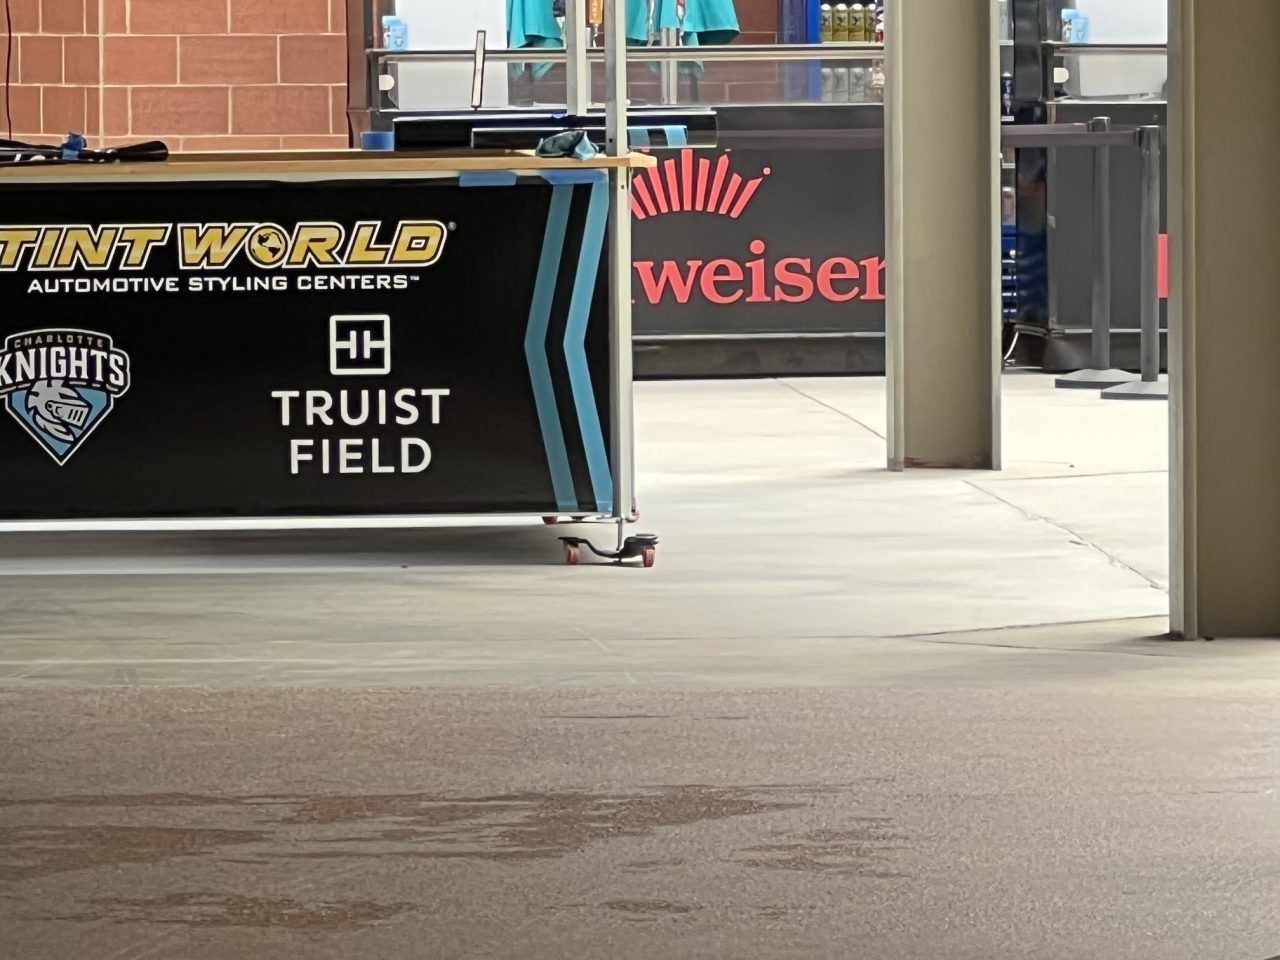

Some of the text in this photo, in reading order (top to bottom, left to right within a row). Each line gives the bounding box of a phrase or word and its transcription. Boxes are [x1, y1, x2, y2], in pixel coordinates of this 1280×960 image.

[27, 276, 180, 294] AUTOMOTIVE
[188, 276, 288, 292] STYLING
[14, 334, 103, 349] CHARLOTTE
[271, 388, 451, 426] TRUIST
[290, 437, 432, 474] FIELD
